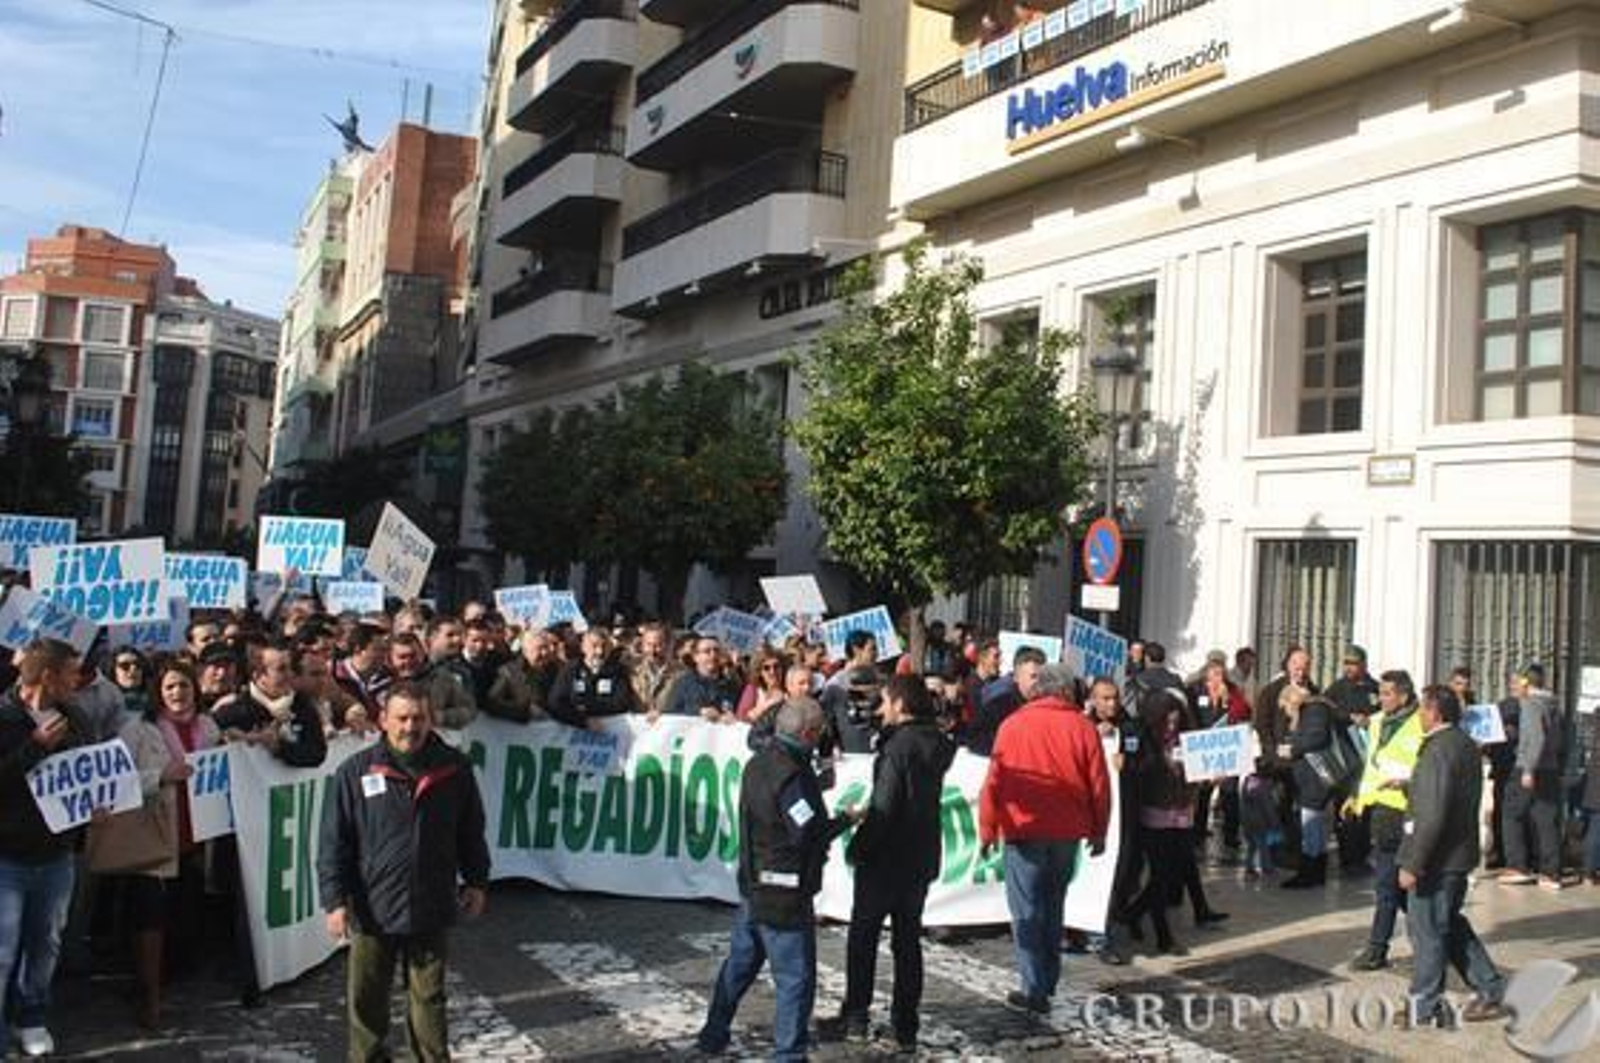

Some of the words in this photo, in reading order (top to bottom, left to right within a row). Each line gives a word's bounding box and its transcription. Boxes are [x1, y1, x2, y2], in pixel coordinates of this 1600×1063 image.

[1006, 60, 1127, 140] Huelva
[1130, 40, 1230, 94] Información
[264, 520, 339, 547] ¡¡AGUA
[164, 556, 240, 583] ¡¡AGUA
[283, 546, 327, 572] YA!!
[184, 581, 229, 606] YA!!
[34, 745, 132, 799] ¡¡AGUA
[60, 782, 117, 823] YA!!
